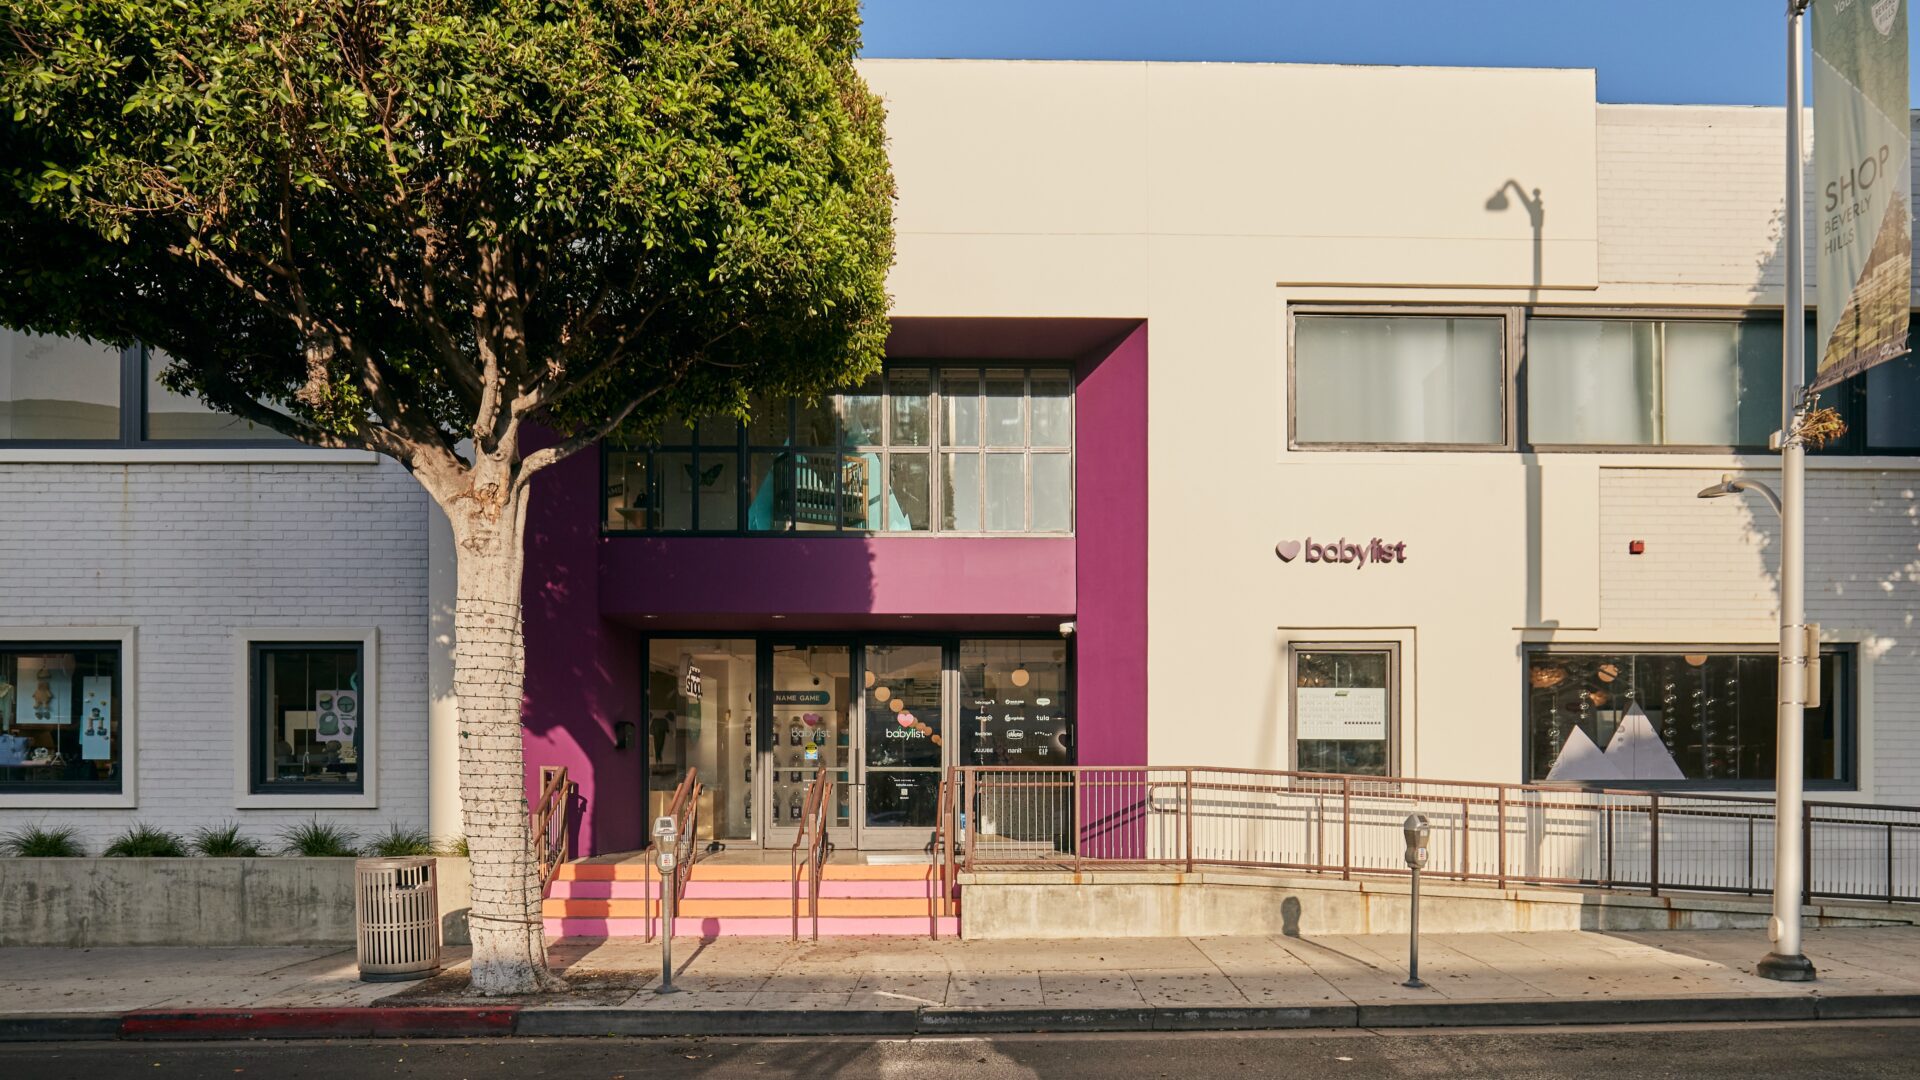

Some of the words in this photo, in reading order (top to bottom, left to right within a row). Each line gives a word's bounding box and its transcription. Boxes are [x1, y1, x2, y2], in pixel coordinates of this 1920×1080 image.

[1825, 144, 1889, 212] SHOP
[1824, 193, 1872, 236] BEVERLY
[1824, 228, 1854, 257] HILLS
[1305, 537, 1407, 570] babylist
[791, 727, 831, 739] babylist
[885, 728, 926, 741] babylist
